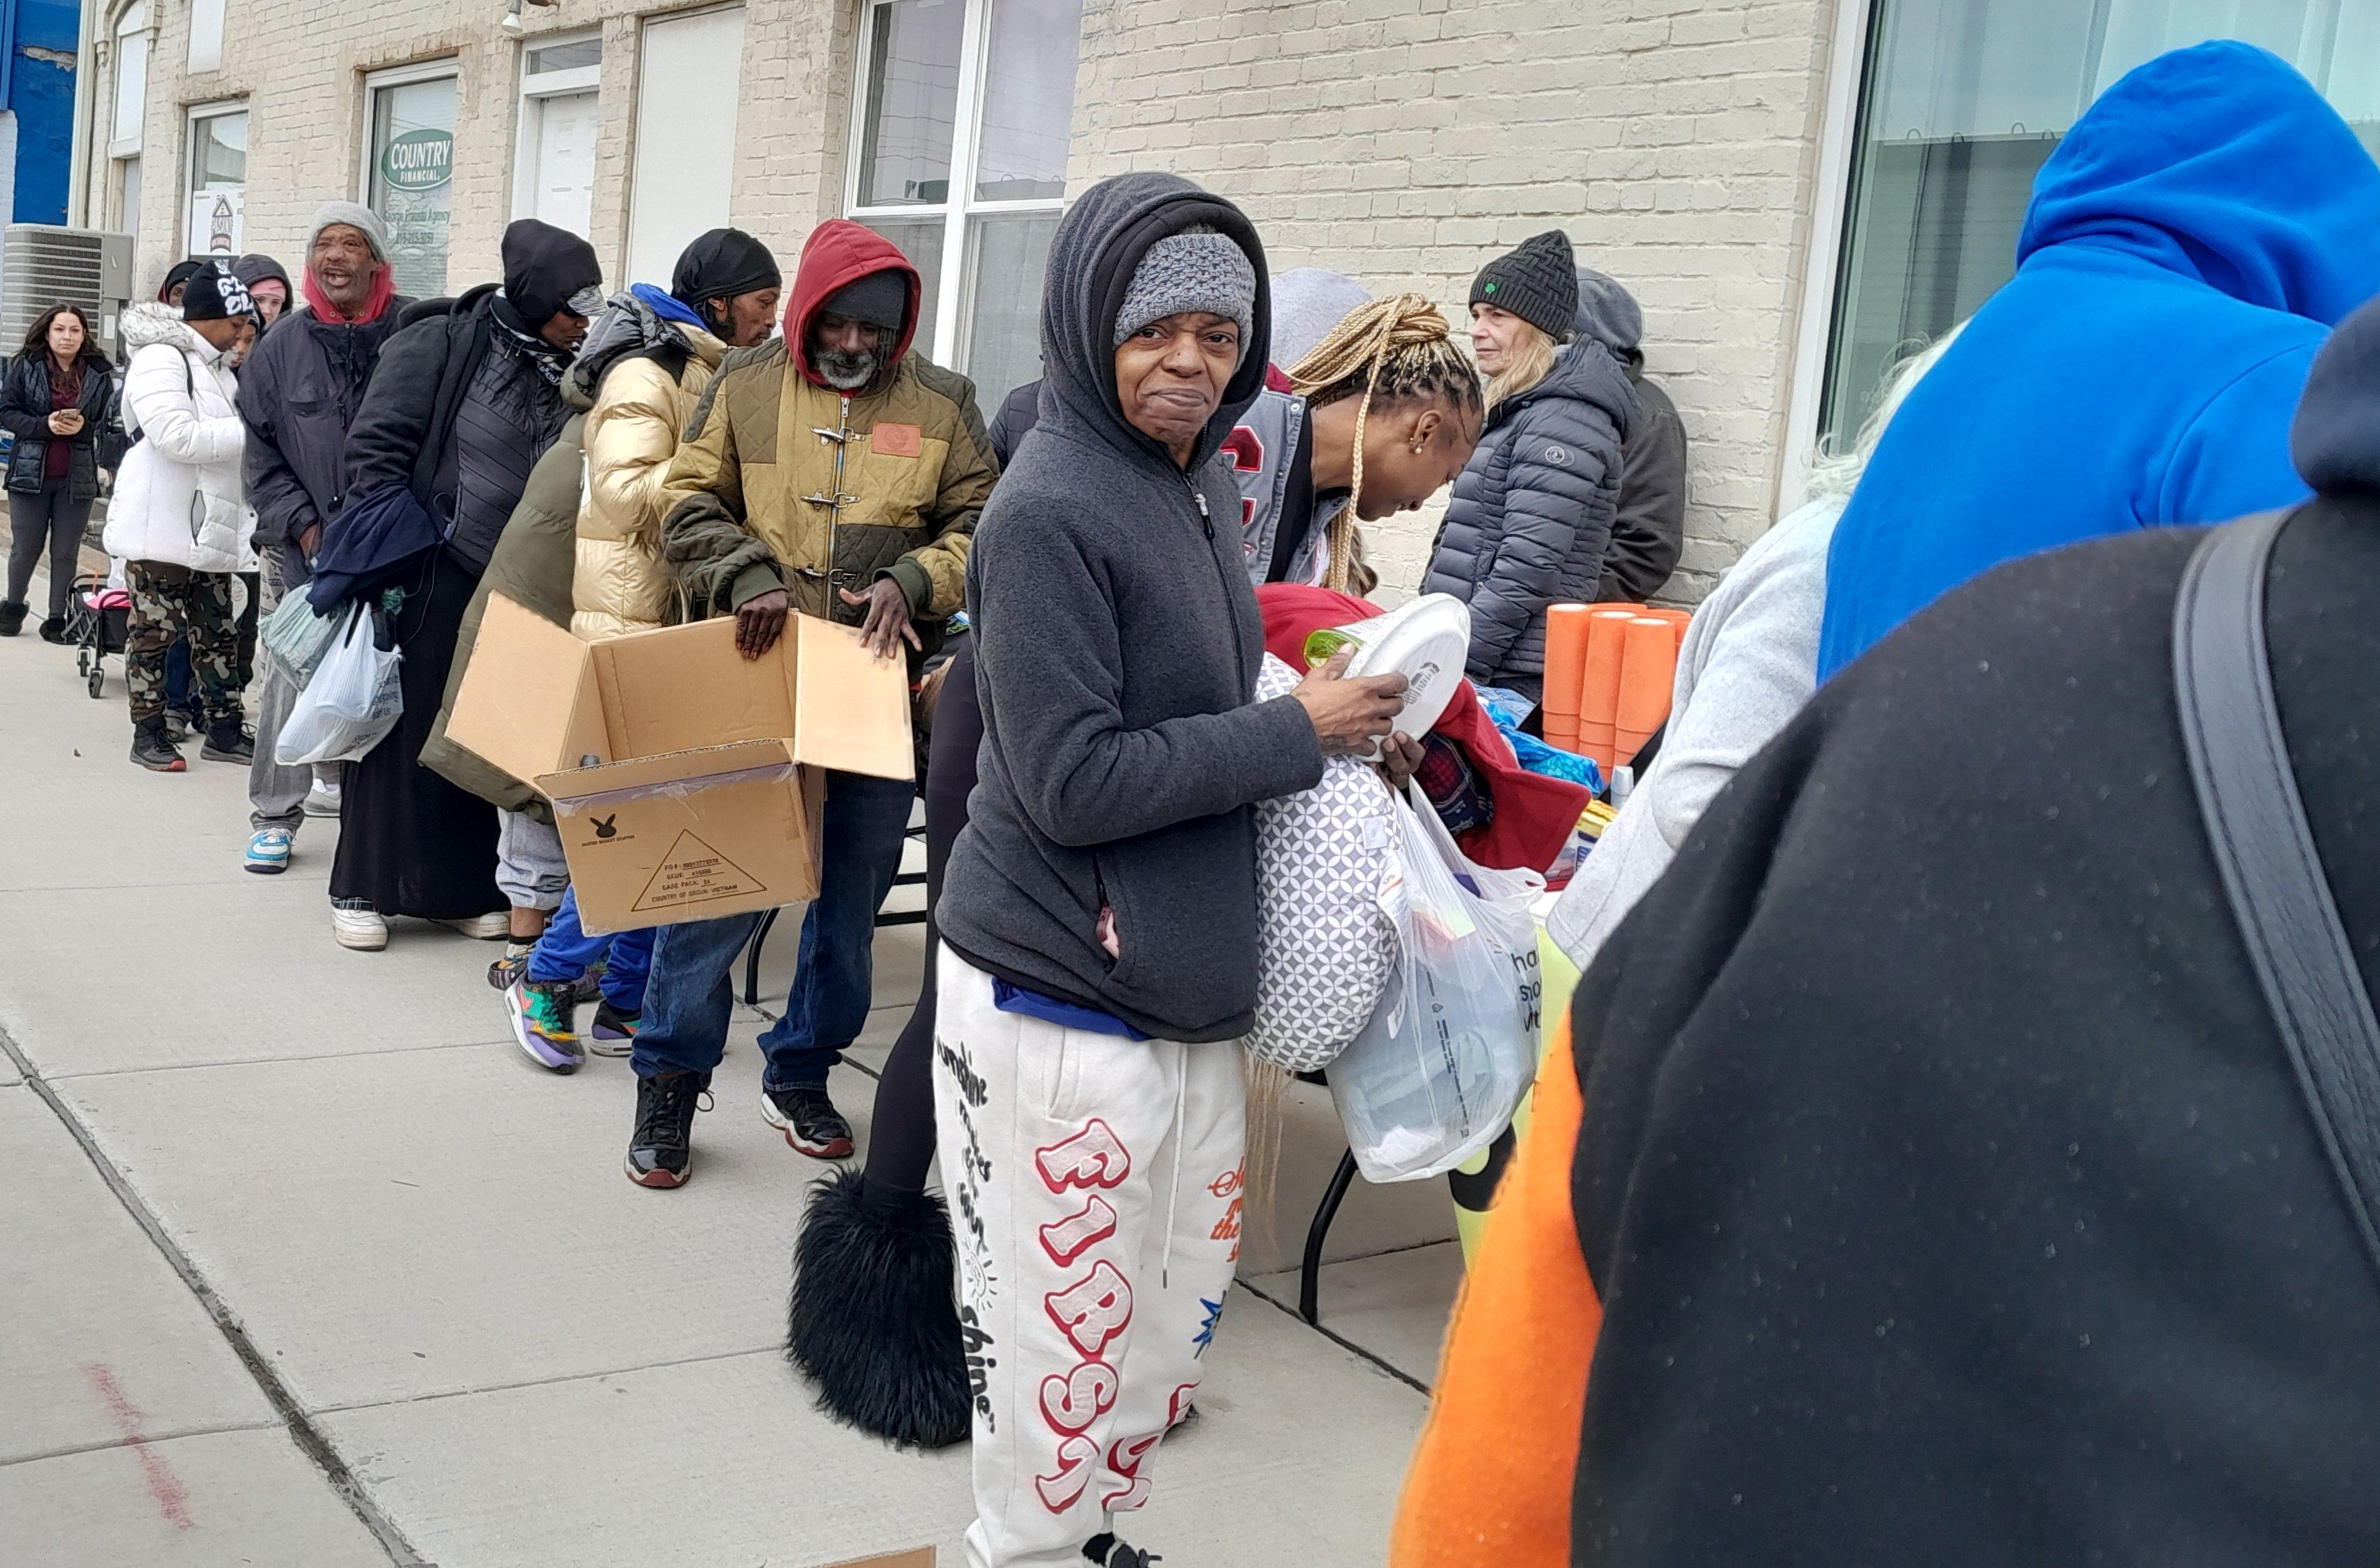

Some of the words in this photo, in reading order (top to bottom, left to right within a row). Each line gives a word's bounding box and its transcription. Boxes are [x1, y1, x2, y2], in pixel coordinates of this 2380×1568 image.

[391, 139, 452, 170] COUNTRY
[400, 169, 438, 183] FINANCIAL
[428, 208, 451, 225] Agency
[651, 893, 677, 902] COUNTRY
[711, 884, 738, 892] VIETNAM
[1210, 1213, 1241, 1240] the
